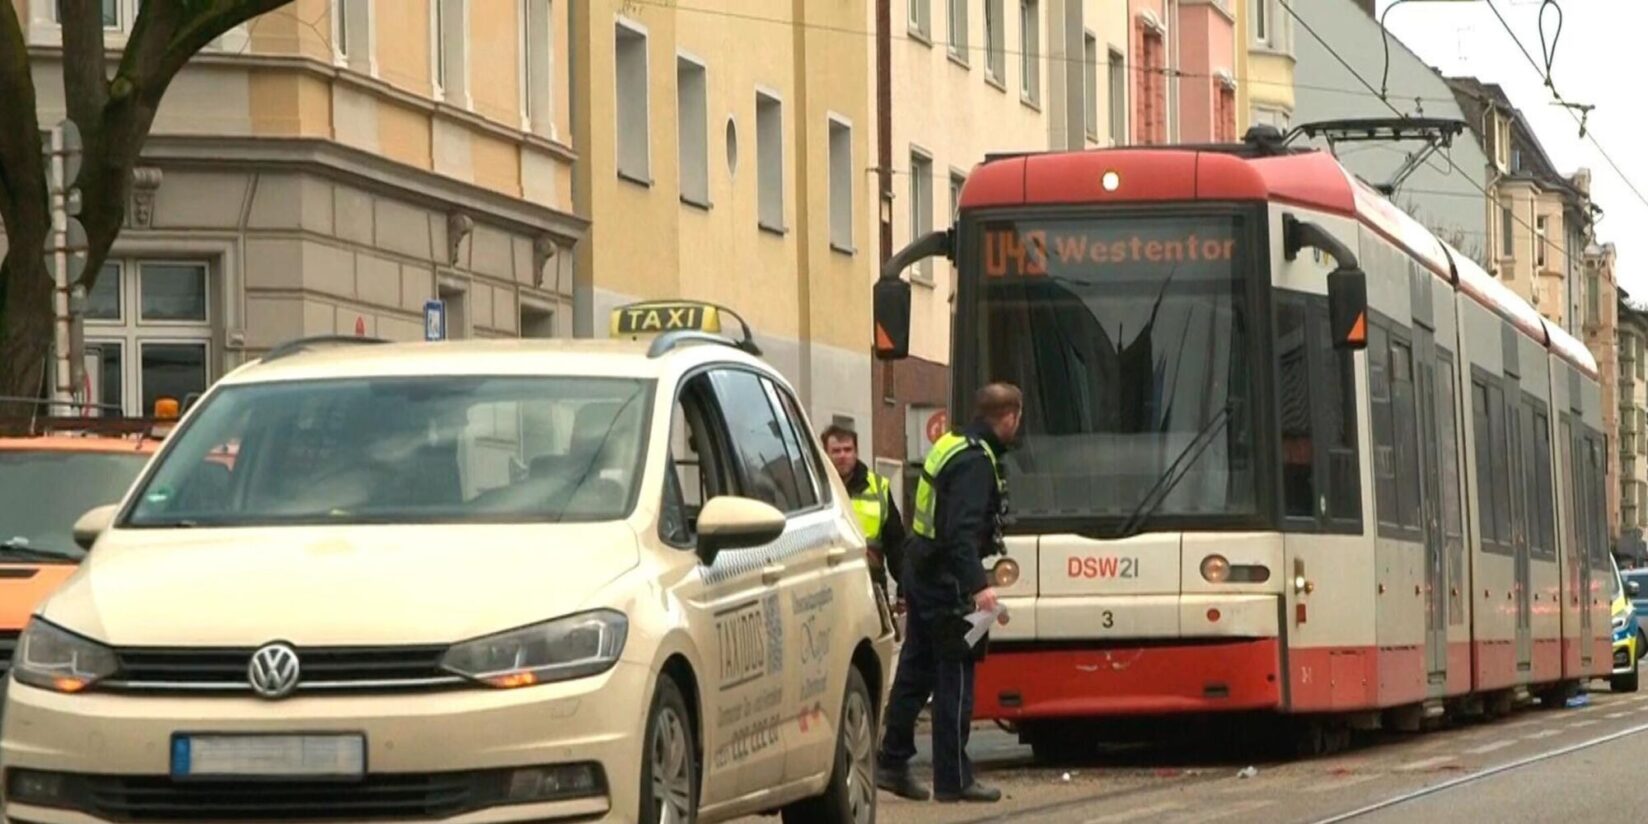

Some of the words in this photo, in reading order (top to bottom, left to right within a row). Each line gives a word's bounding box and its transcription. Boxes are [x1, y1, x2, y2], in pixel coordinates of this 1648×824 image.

[1055, 232, 1236, 263] Westentor
[627, 308, 695, 330] TAXI
[1068, 556, 1139, 578] DSW21
[1102, 610, 1114, 629] 3
